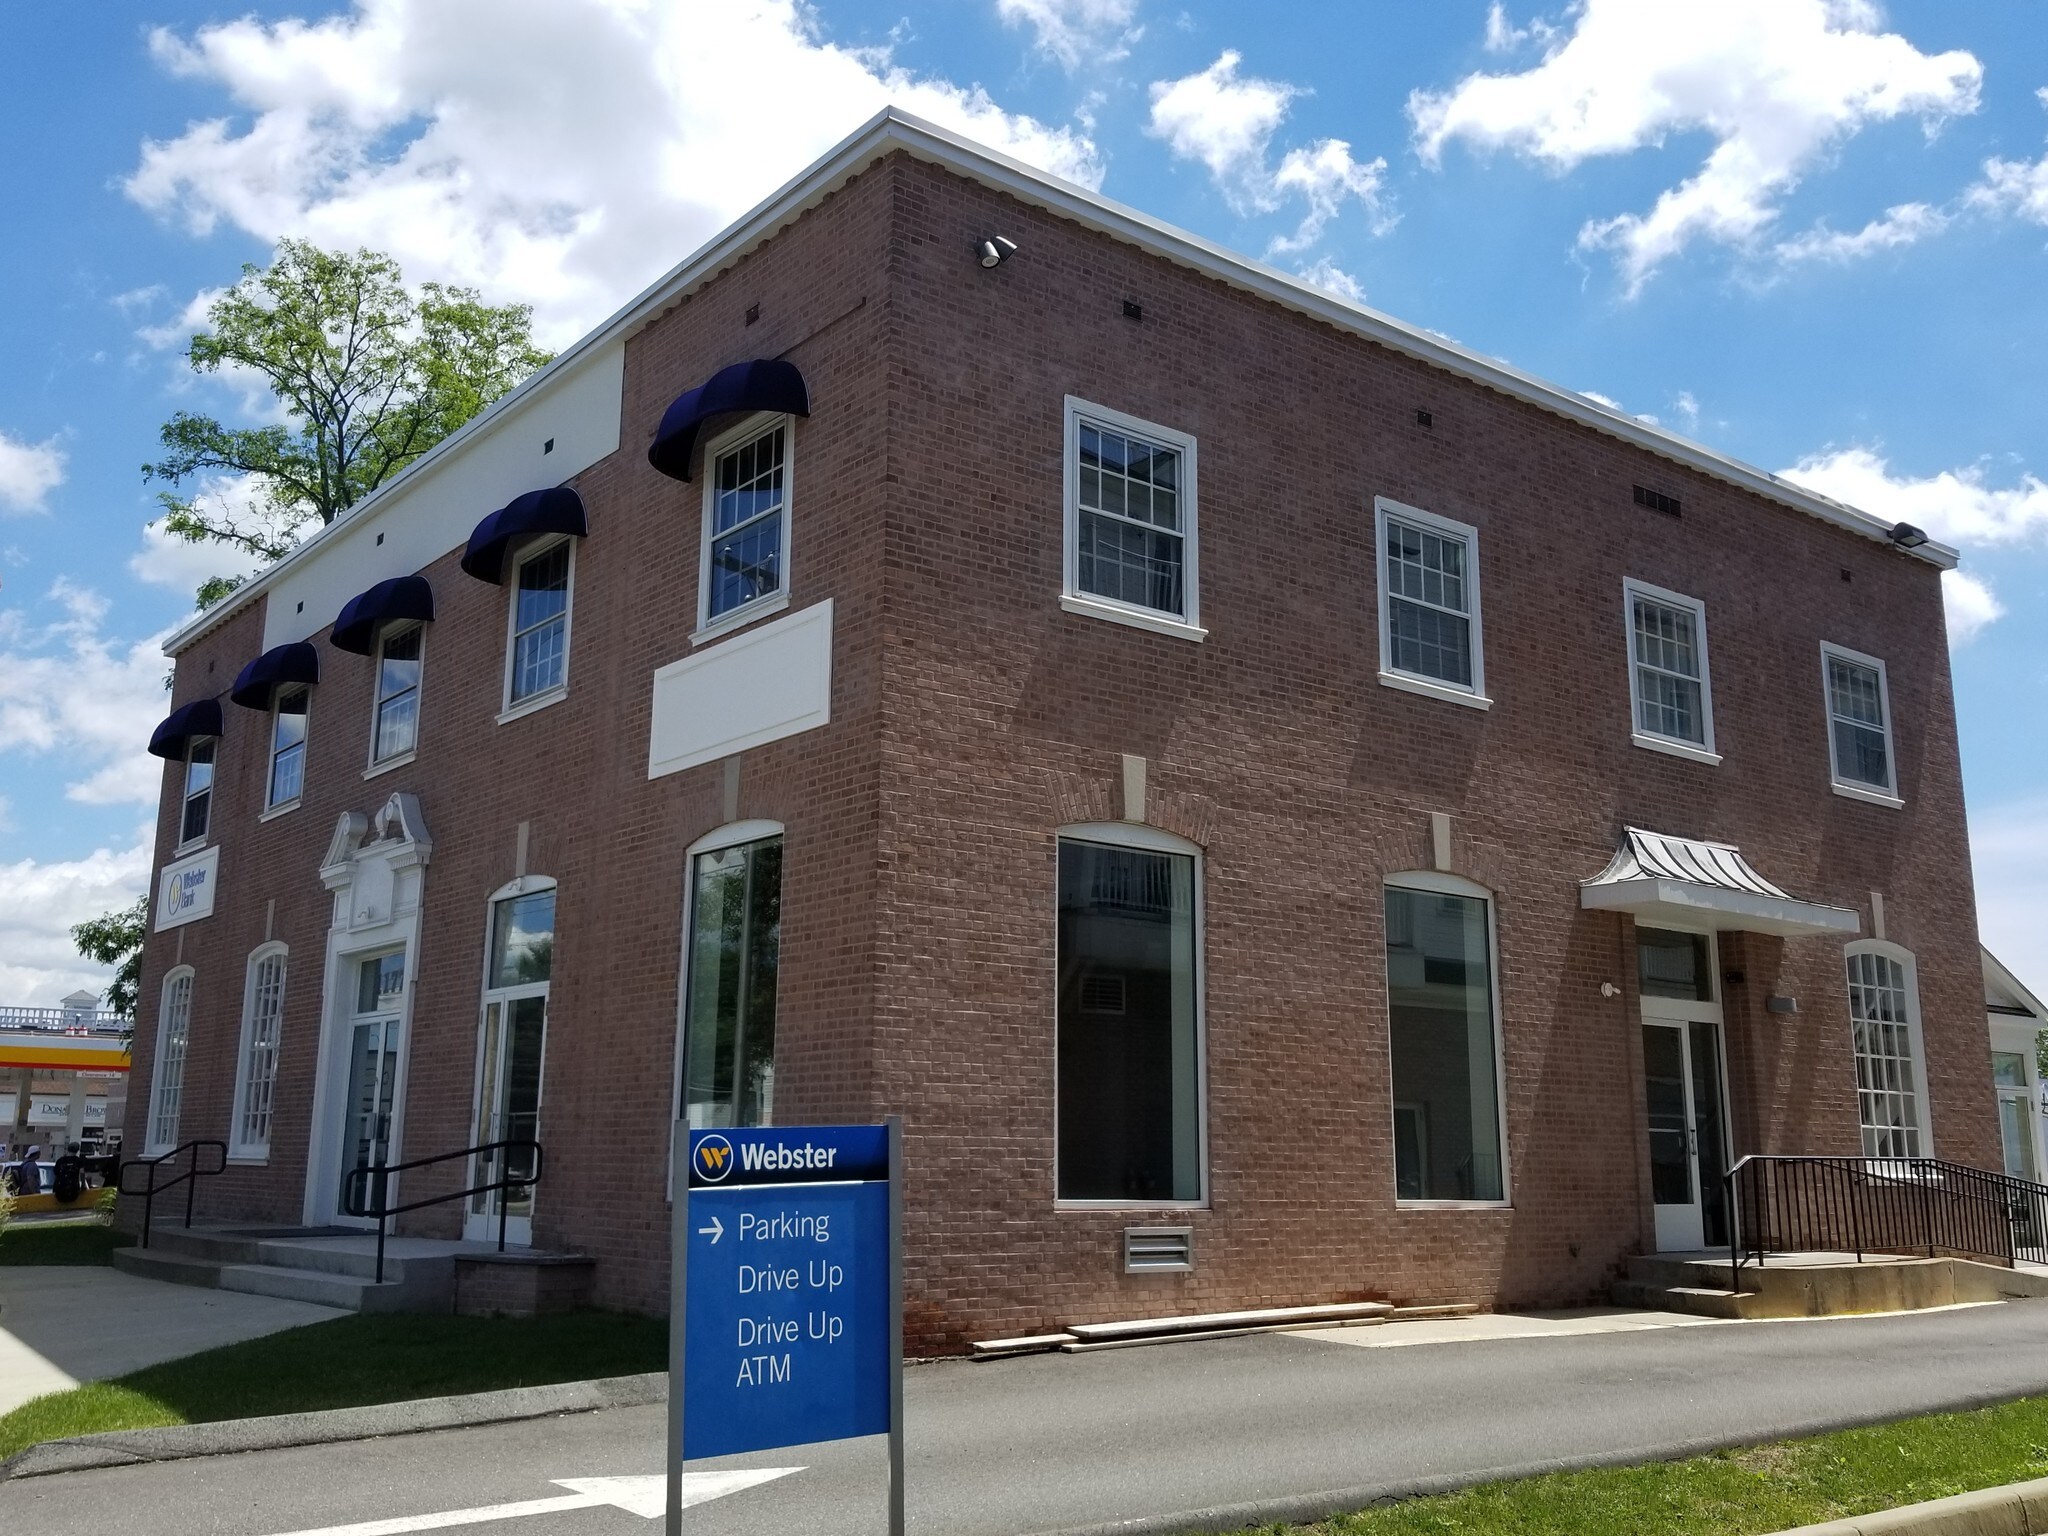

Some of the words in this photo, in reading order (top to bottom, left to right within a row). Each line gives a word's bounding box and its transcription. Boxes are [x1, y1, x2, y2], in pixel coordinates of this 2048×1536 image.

[183, 869, 206, 890] Webster
[181, 889, 195, 908] Bank
[741, 1142, 837, 1171] Webster
[739, 1210, 830, 1243] Parking
[738, 1263, 800, 1294] Drive
[808, 1259, 844, 1293] Up
[737, 1316, 799, 1347] Drive
[808, 1310, 844, 1344] Up
[736, 1353, 791, 1388] ATM
